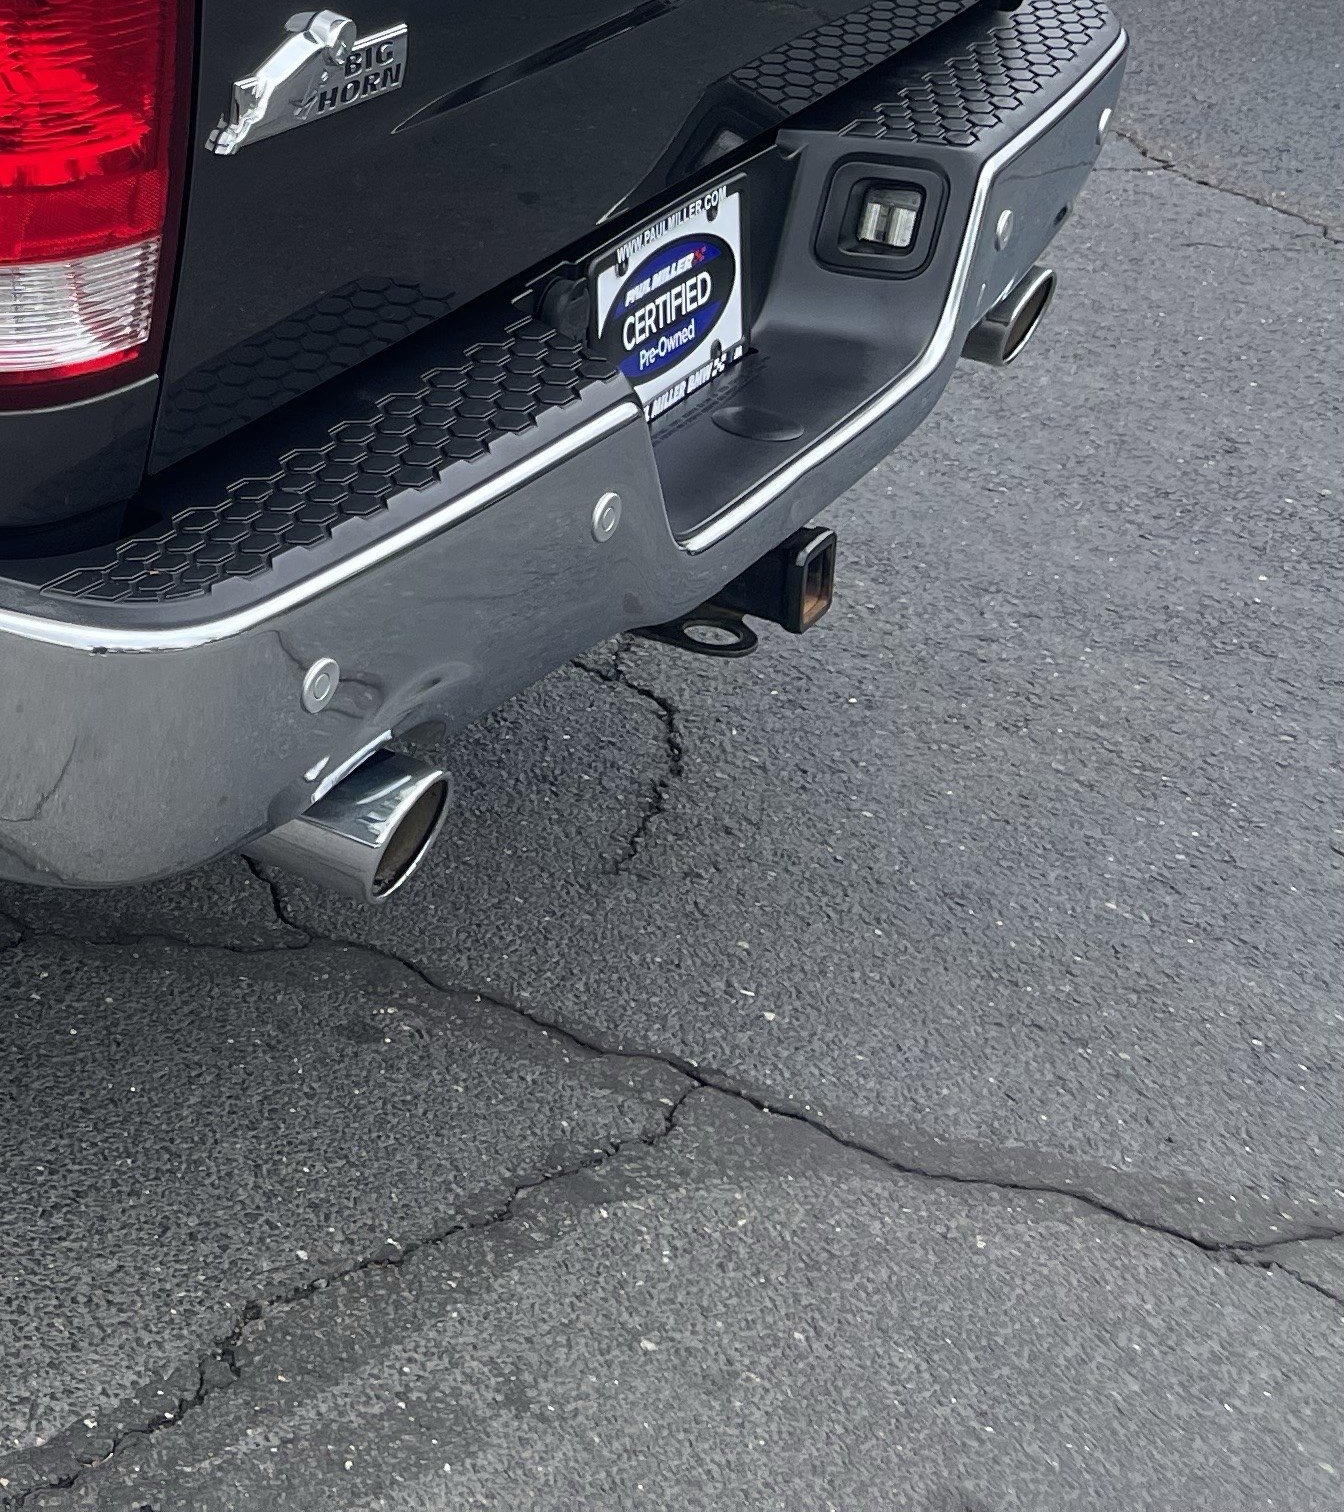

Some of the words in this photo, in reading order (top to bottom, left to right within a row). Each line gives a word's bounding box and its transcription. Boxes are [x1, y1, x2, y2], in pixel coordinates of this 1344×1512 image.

[343, 40, 394, 78] BIG
[317, 62, 403, 114] HORN
[616, 185, 728, 265] WWW.PAULMILLER.COM
[651, 252, 695, 291] MILLER
[622, 271, 713, 352] CERTIFIED
[639, 318, 696, 371] Pre-Owned
[651, 380, 688, 419] MILLER
